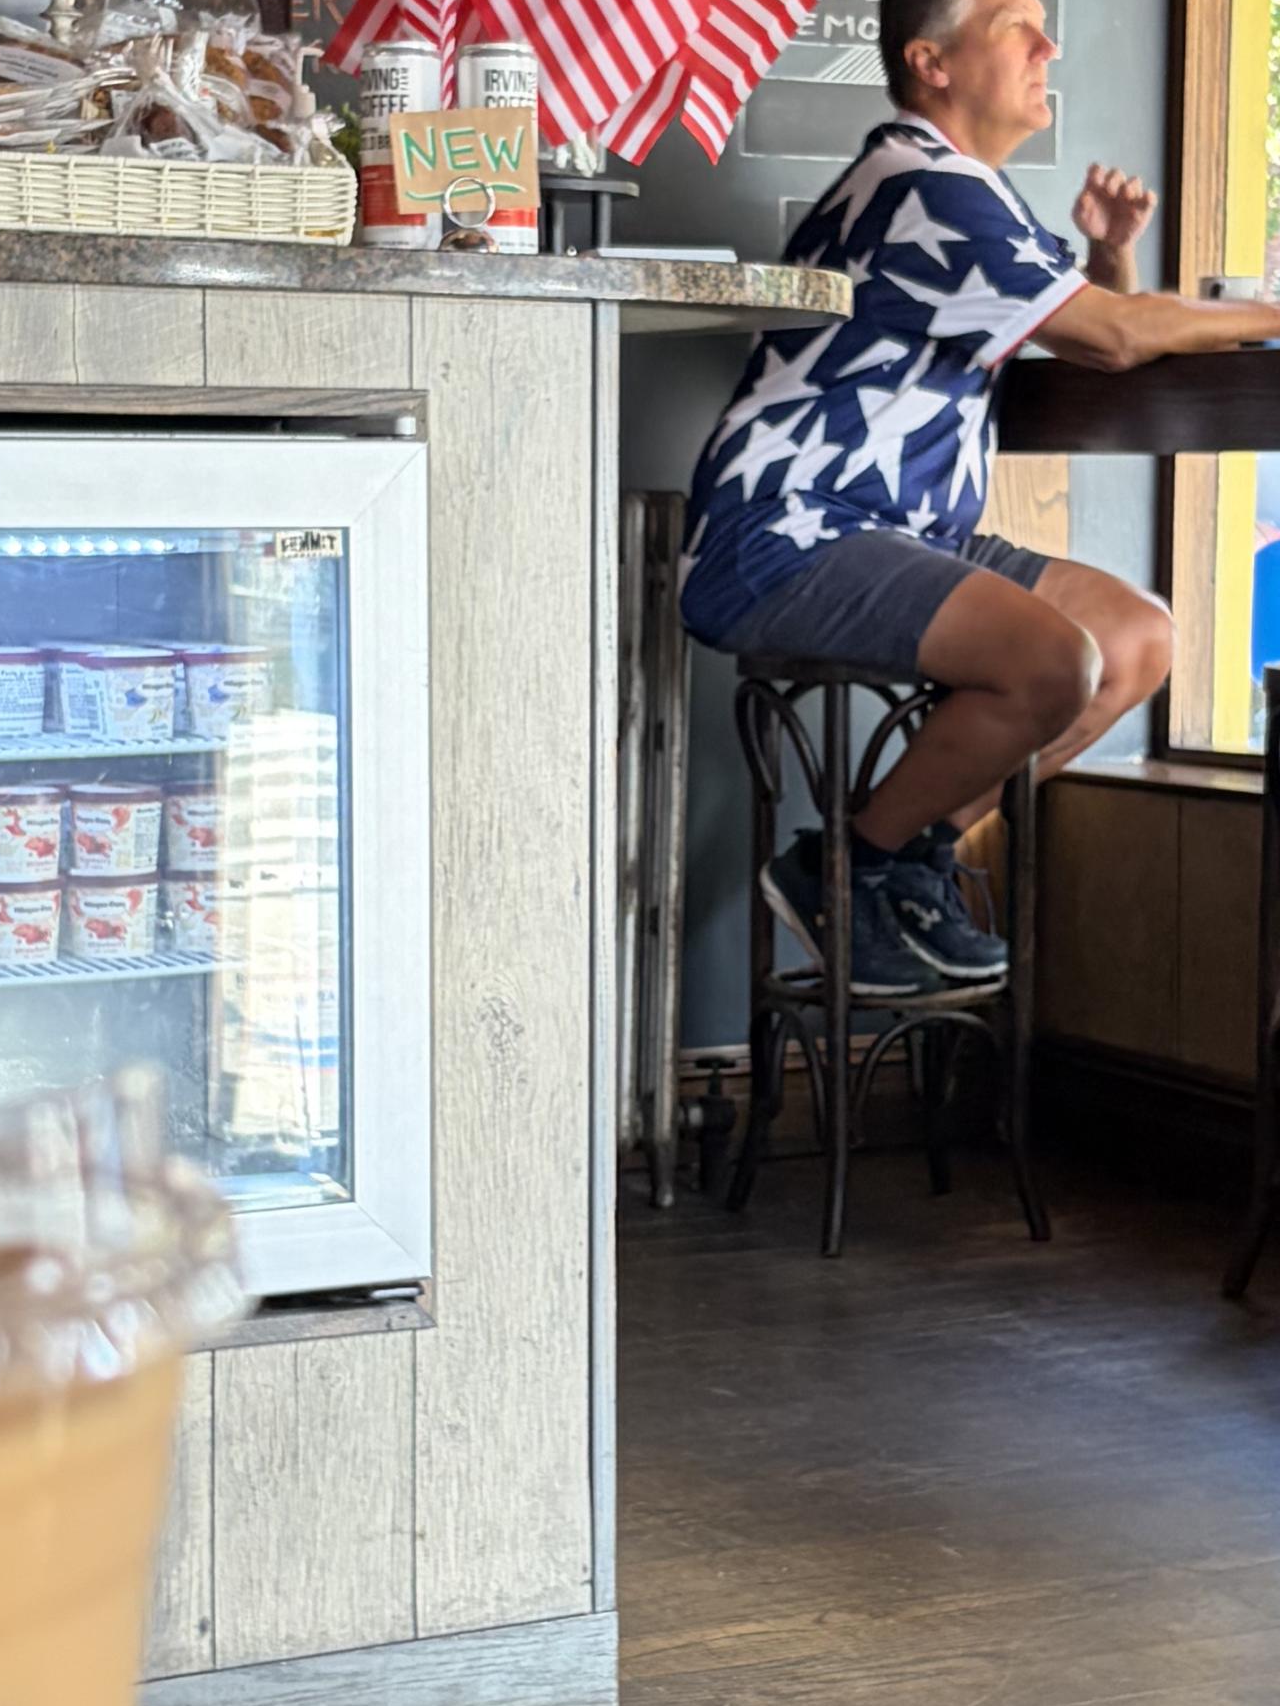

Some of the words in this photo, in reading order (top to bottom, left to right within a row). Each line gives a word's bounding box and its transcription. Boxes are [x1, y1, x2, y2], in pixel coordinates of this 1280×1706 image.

[363, 67, 400, 92] VING
[484, 69, 532, 93] IRVIN
[400, 126, 525, 180] NEW
